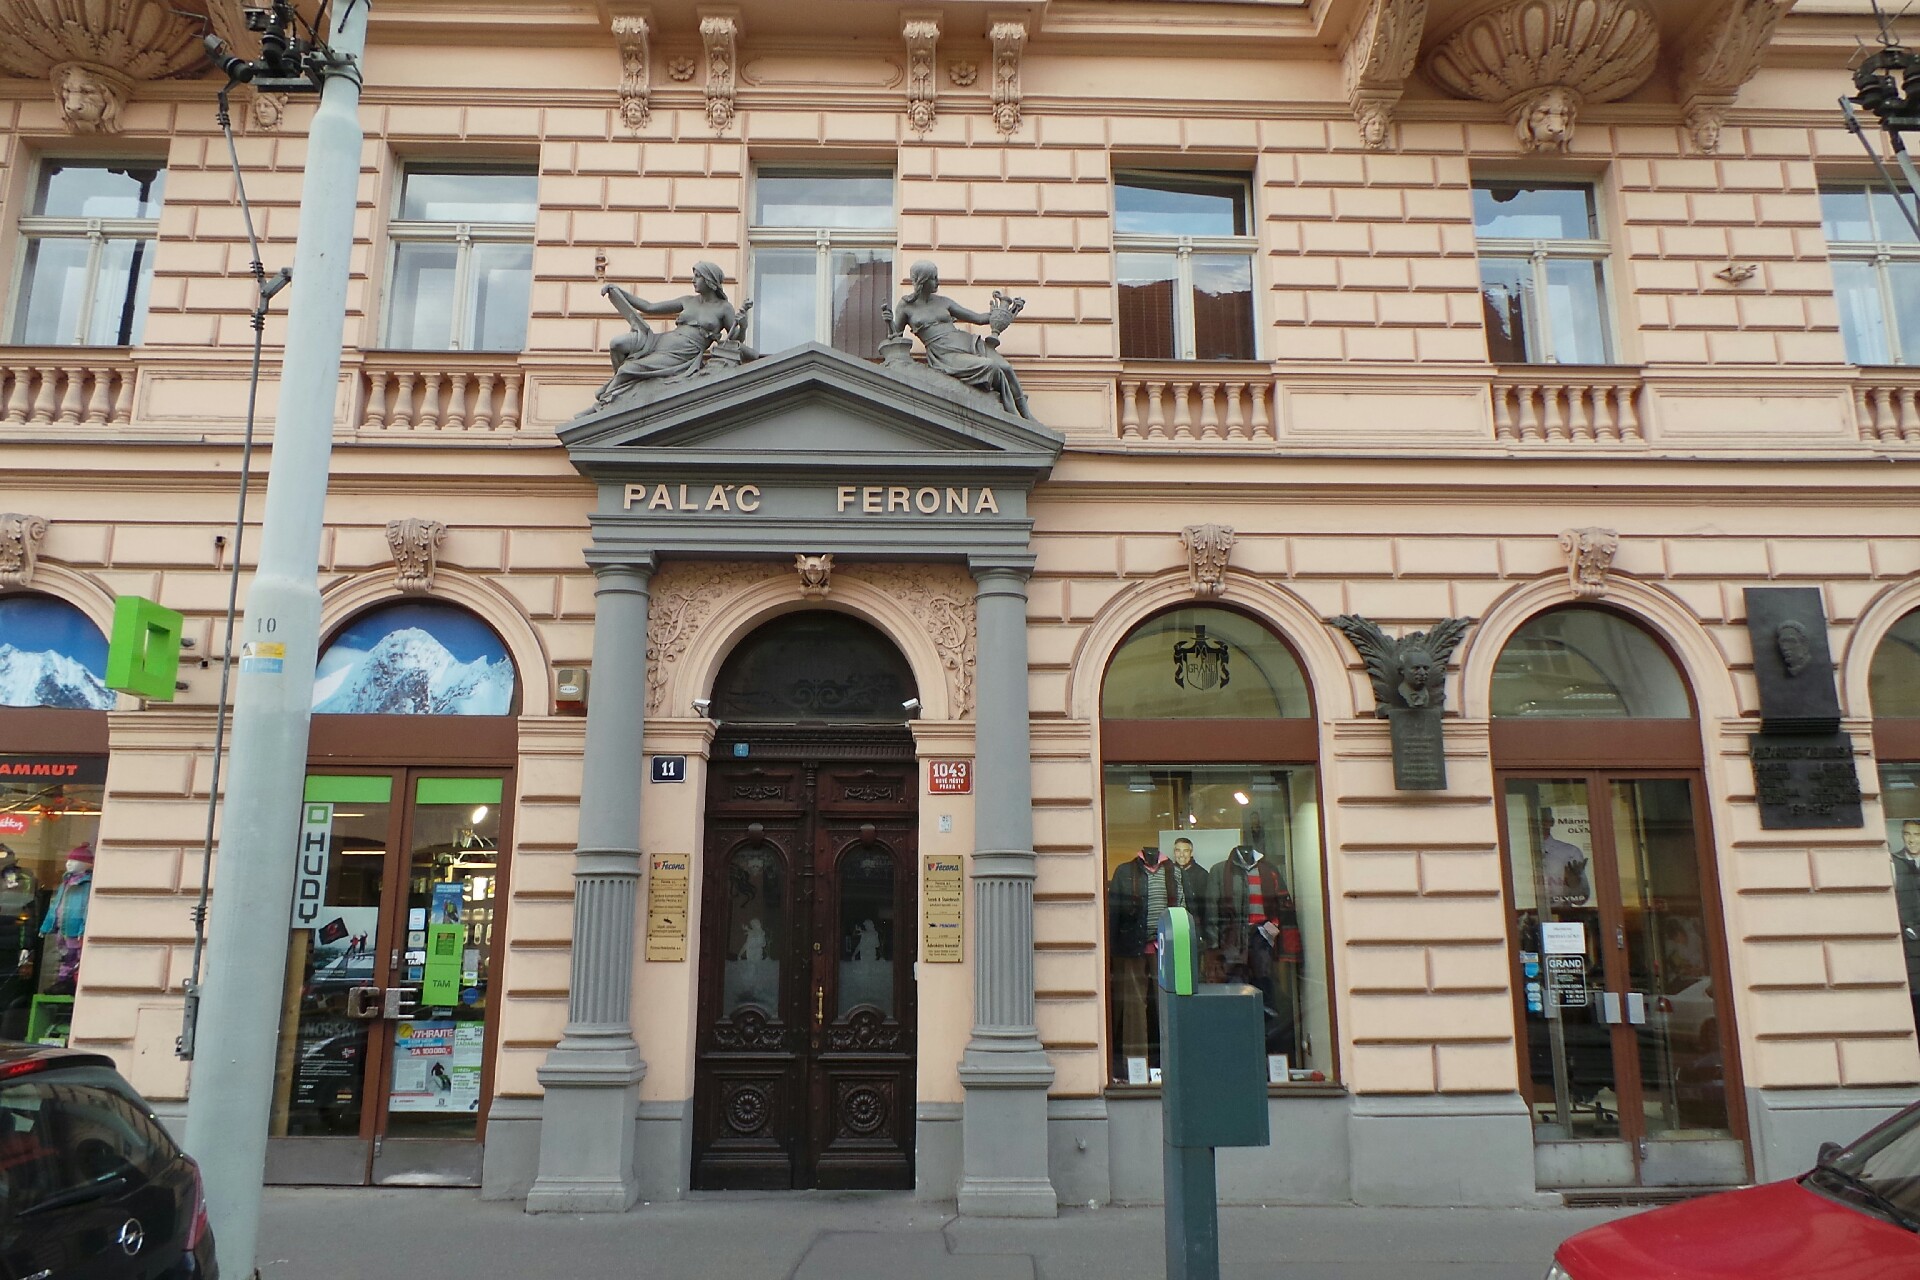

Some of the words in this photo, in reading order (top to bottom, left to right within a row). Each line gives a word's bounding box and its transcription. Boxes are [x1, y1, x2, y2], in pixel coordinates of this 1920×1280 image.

[623, 483, 761, 513] PALÁC
[837, 486, 999, 515] FERONA
[257, 617, 277, 633] 10
[661, 761, 675, 776] 11
[933, 763, 967, 778] 1043
[298, 831, 326, 924] HUDY
[1549, 959, 1582, 968] GRAND
[432, 979, 451, 988] TAM
